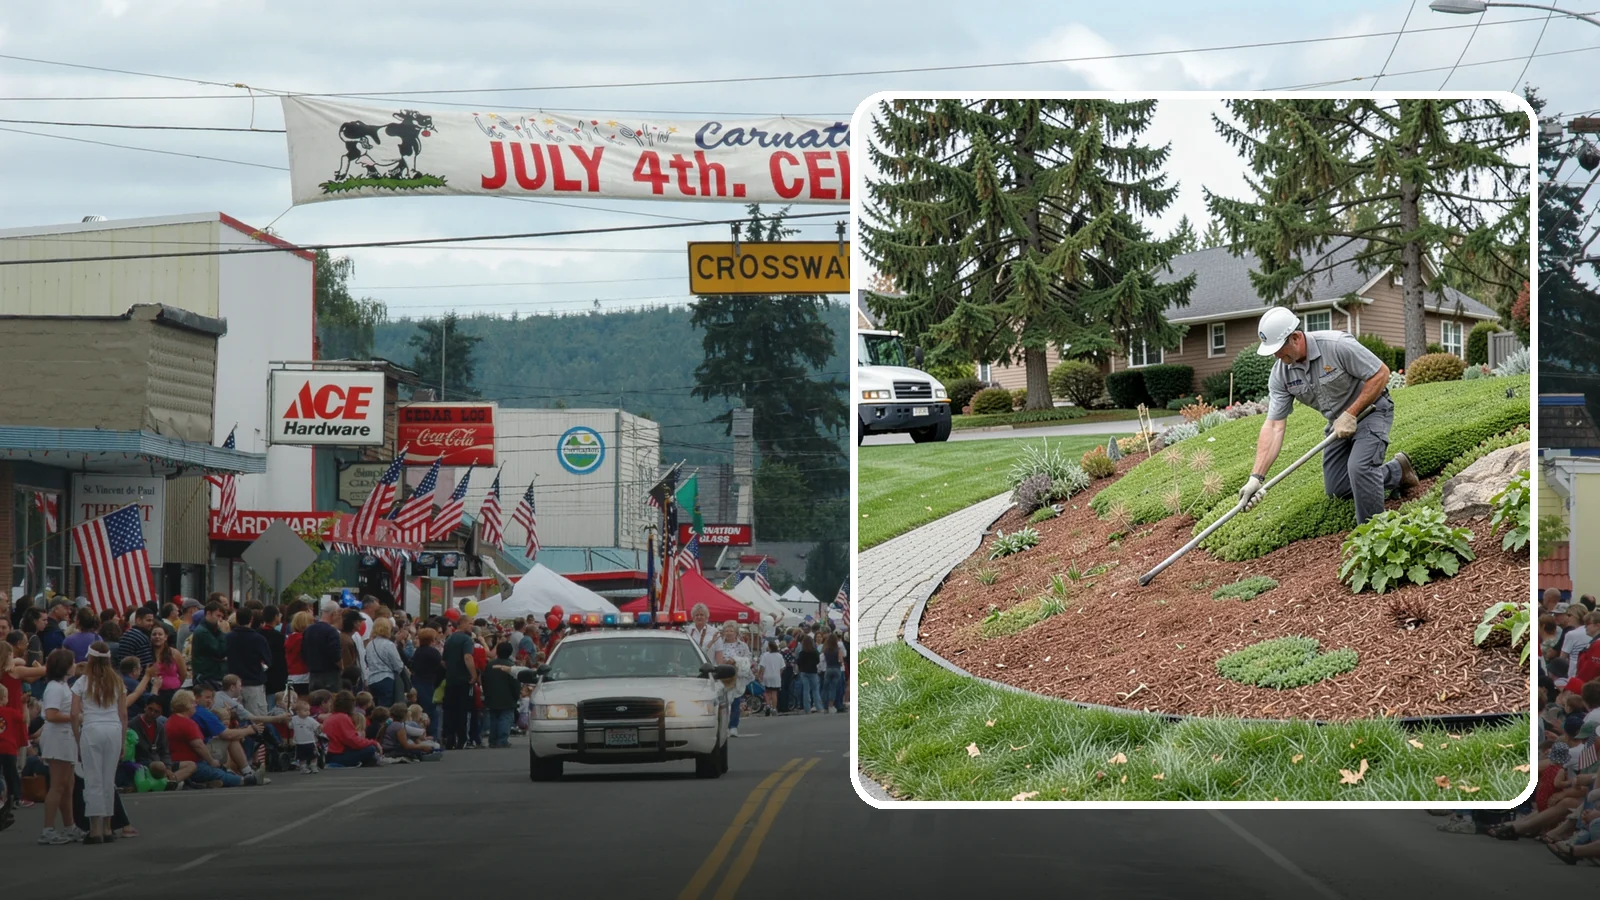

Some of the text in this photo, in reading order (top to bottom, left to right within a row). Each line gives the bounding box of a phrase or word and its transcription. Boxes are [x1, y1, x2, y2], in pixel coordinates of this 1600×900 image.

[694, 121, 850, 149] Carnat
[481, 140, 605, 192] JULY
[632, 150, 746, 198] 4th.
[696, 254, 850, 280] CROSSWA
[282, 380, 373, 420] ACE
[405, 409, 485, 422] CEDAR LOG
[283, 421, 371, 436] Hardware
[416, 427, 477, 447] Coca-Cola
[353, 466, 384, 480] Simpl
[83, 485, 155, 496] St. Vincent de Paul
[81, 503, 154, 522] THT
[212, 516, 331, 536] HRDARE
[688, 526, 741, 535] CRNATION
[698, 535, 730, 544] GLASS
